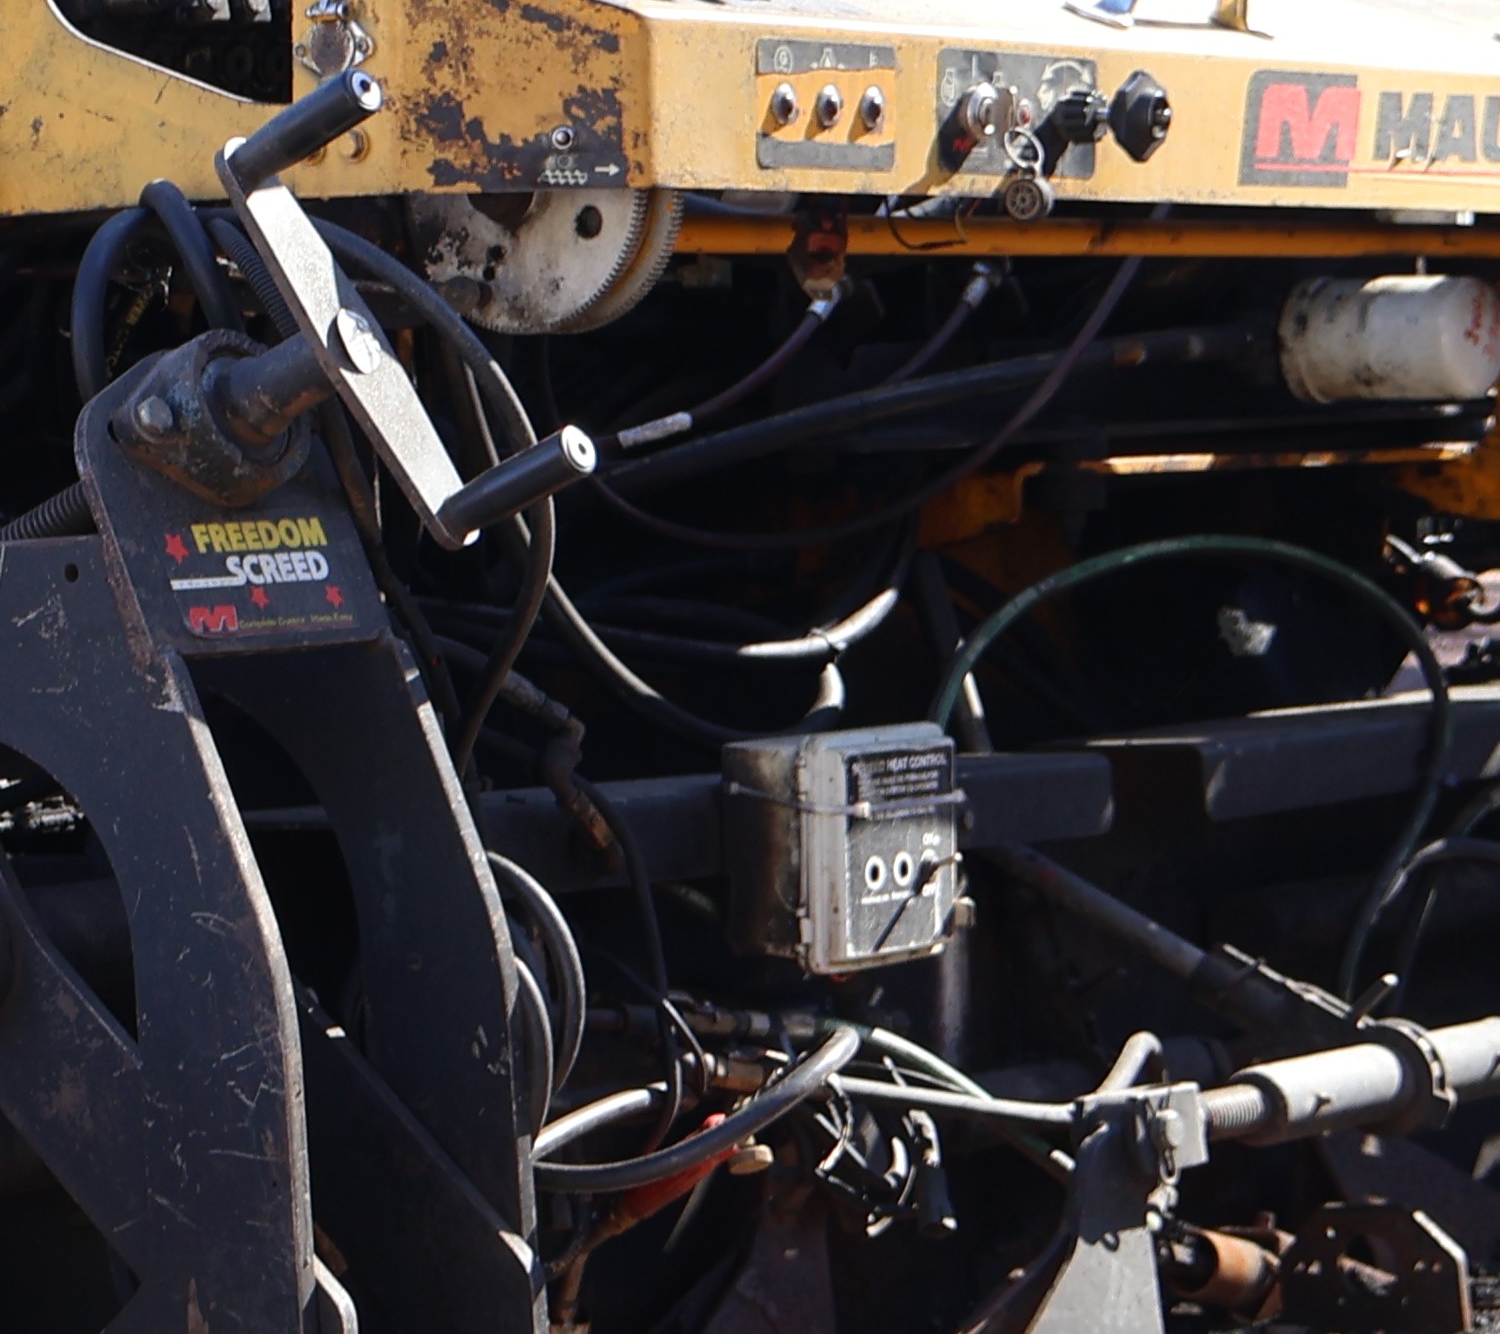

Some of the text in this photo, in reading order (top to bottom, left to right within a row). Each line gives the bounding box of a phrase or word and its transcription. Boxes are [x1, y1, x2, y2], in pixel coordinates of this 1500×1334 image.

[190, 517, 328, 555] FREEDOM
[225, 549, 330, 586] SCREED
[909, 752, 947, 769] CONTROL
